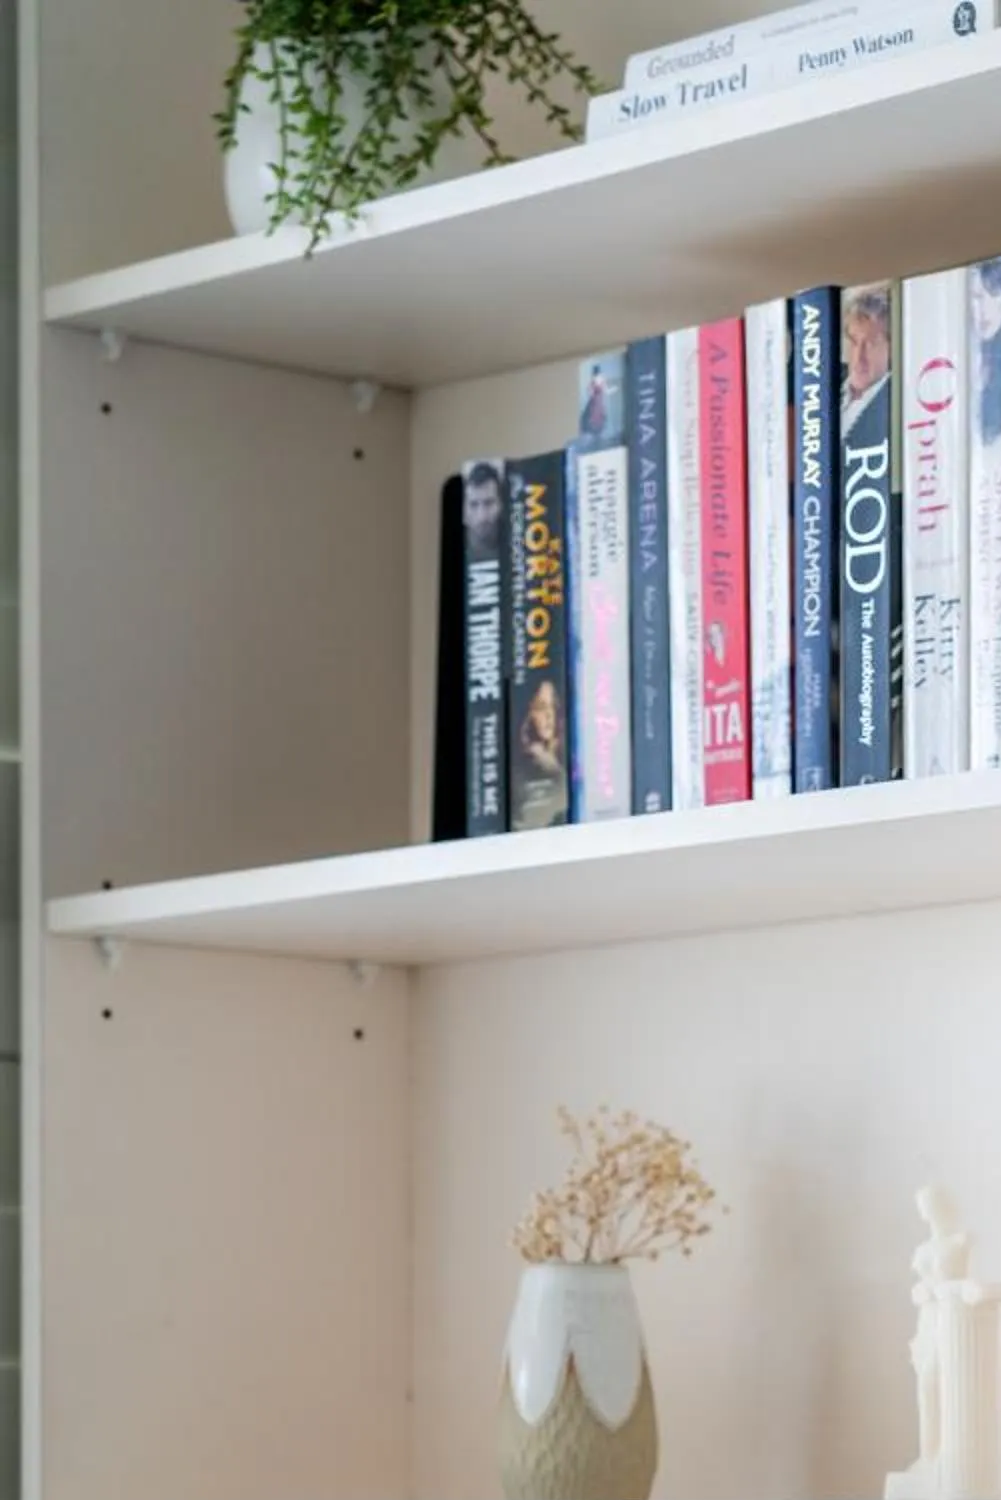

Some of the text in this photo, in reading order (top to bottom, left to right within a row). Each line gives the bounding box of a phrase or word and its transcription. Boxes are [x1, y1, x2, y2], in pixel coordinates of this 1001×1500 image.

[616, 62, 748, 122] Slow Travel
[646, 33, 736, 79] Grounded
[798, 28, 914, 73] Penny Watson
[639, 369, 658, 573] TINA ARENA
[708, 342, 735, 606] A Passionate Life
[800, 303, 822, 638] ANDY MURRAY CHAMPION
[907, 356, 958, 533] Oprah
[525, 482, 551, 669] MORTON
[543, 538, 563, 606] KATE
[844, 437, 890, 594] ROD
[467, 559, 501, 703] IAN THORPE
[858, 597, 876, 748] The Autobiography
[910, 593, 936, 689] Kelley
[934, 597, 962, 684] Kitty
[482, 712, 499, 816] THIS IS ME
[704, 702, 744, 747] ITA
